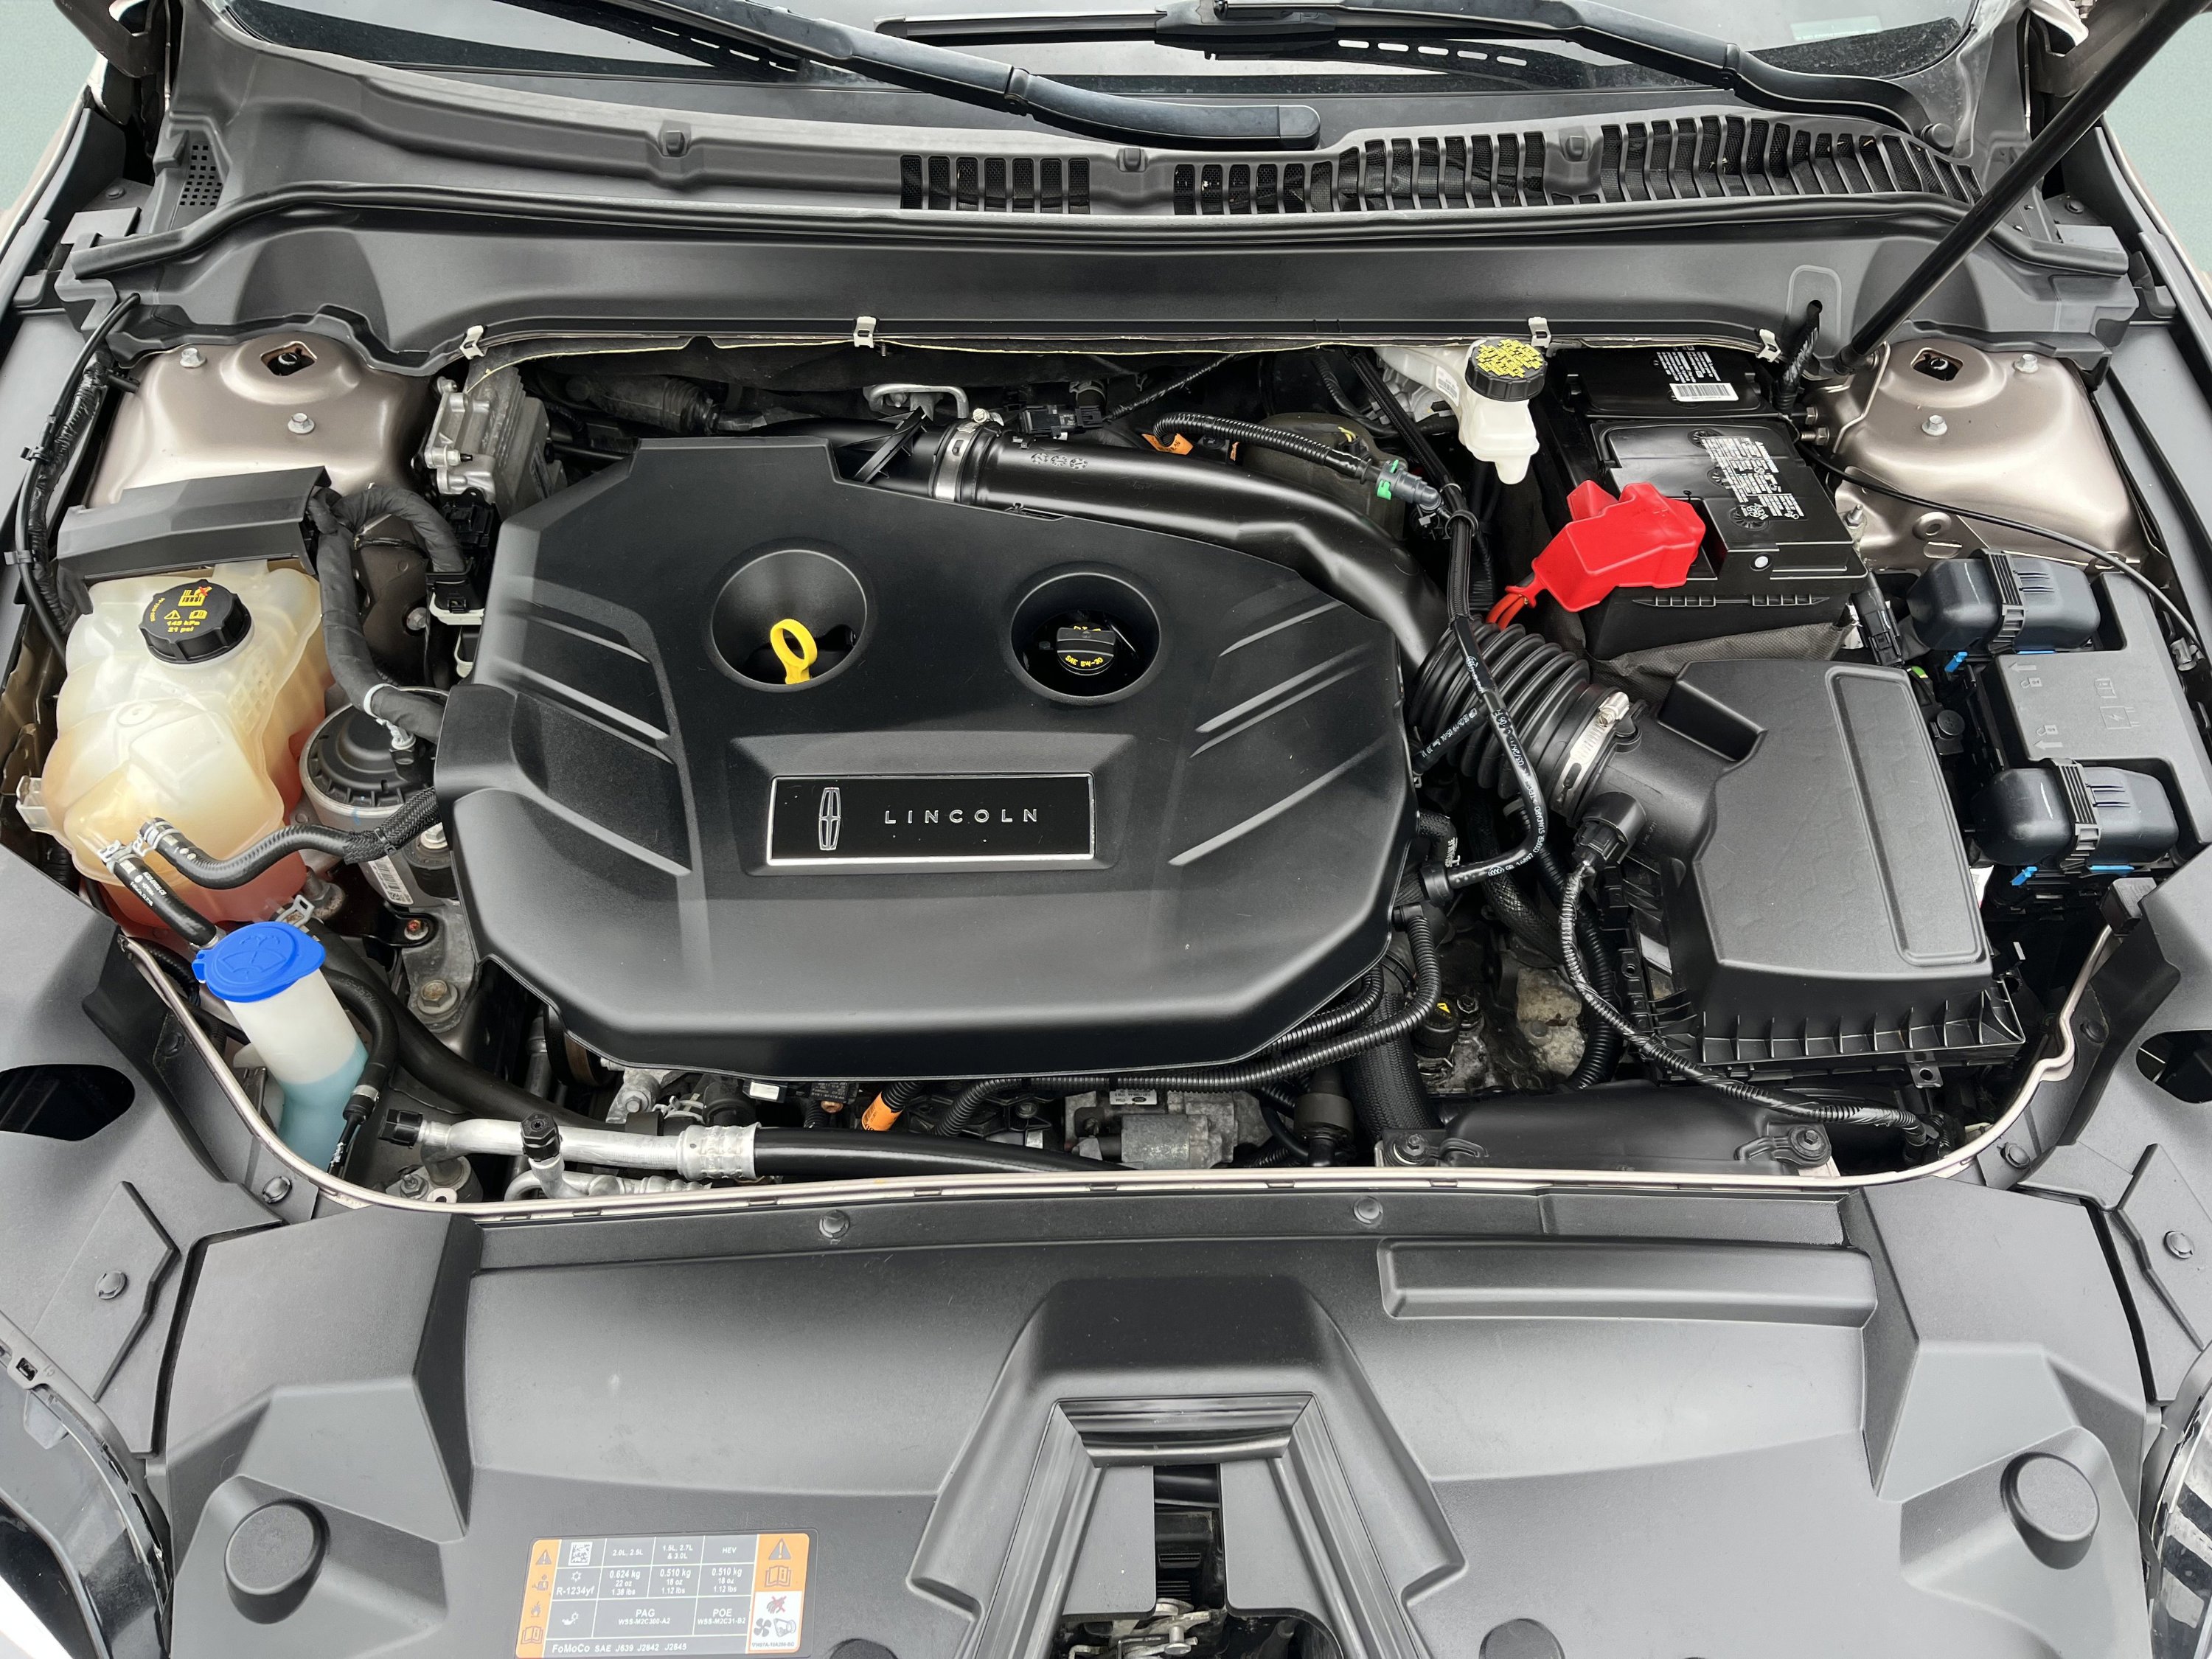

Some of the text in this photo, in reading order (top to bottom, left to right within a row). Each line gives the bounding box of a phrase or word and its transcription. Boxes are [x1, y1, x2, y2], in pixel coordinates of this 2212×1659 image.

[1065, 655, 1079, 666] SAE
[884, 808, 1038, 825] LINCOLN
[1534, 806, 1546, 835] STANDARD
[609, 1568, 641, 1580] 0.624 kg
[659, 1568, 692, 1579] 0.510 kg
[711, 1566, 742, 1577] 0.510 kg
[556, 1585, 595, 1596] R-1234yf
[661, 1587, 674, 1595] 1.12
[635, 1608, 655, 1618] PAG
[712, 1608, 733, 1618] POE
[552, 1644, 590, 1653] FoMoCo
[594, 1644, 611, 1652] SAE
[615, 1644, 634, 1652] J639
